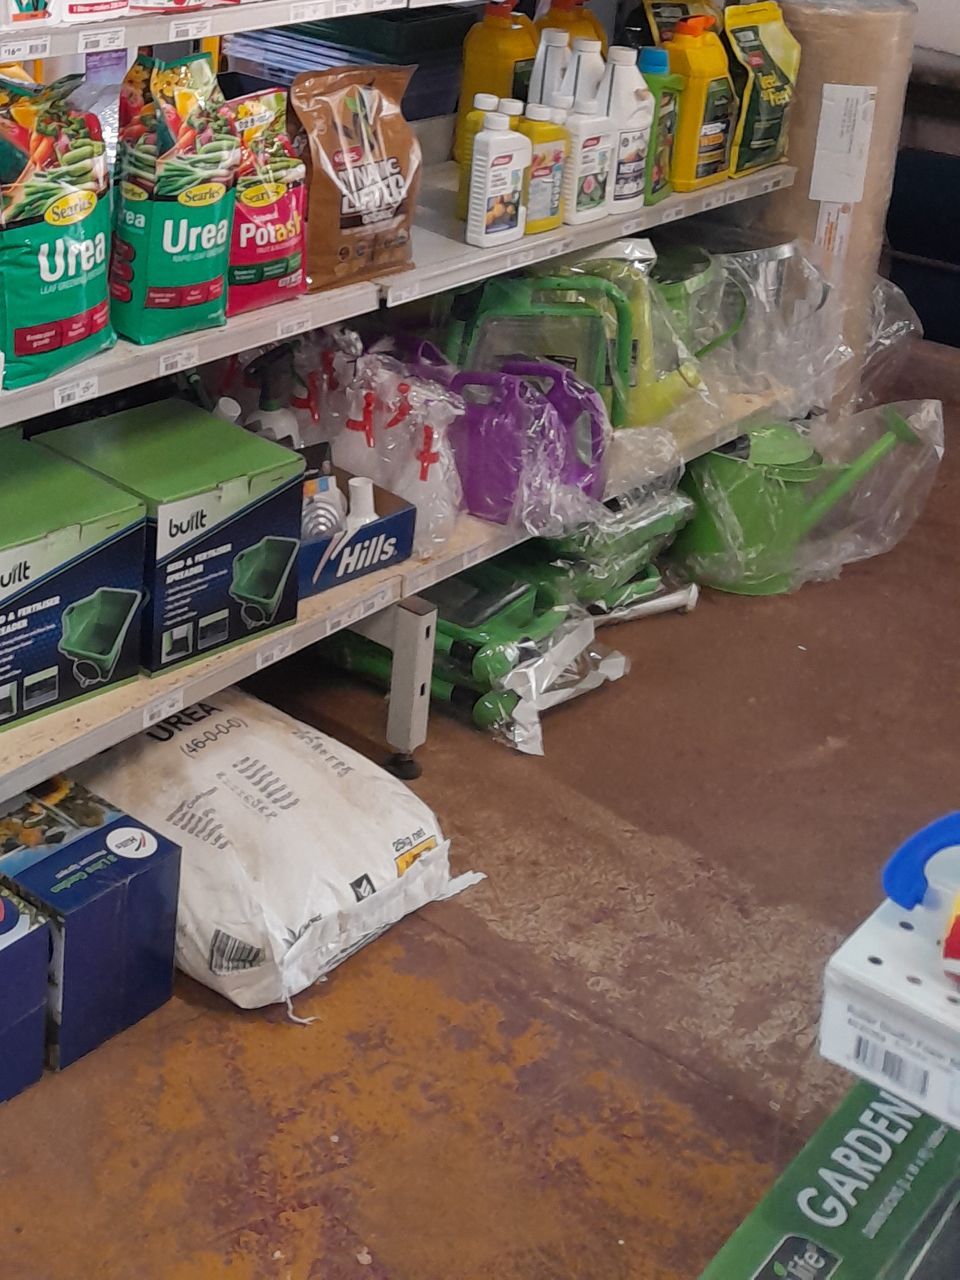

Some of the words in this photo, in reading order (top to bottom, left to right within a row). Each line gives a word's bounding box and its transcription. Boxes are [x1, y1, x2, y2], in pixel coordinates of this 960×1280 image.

[124, 210, 145, 227] rea
[162, 219, 228, 254] Urea
[37, 231, 106, 283] Urea
[168, 509, 207, 538] built
[337, 533, 396, 578] Hills
[146, 701, 222, 743] UREA
[114, 834, 138, 852] Hills
[797, 1090, 923, 1229] GARDEN
